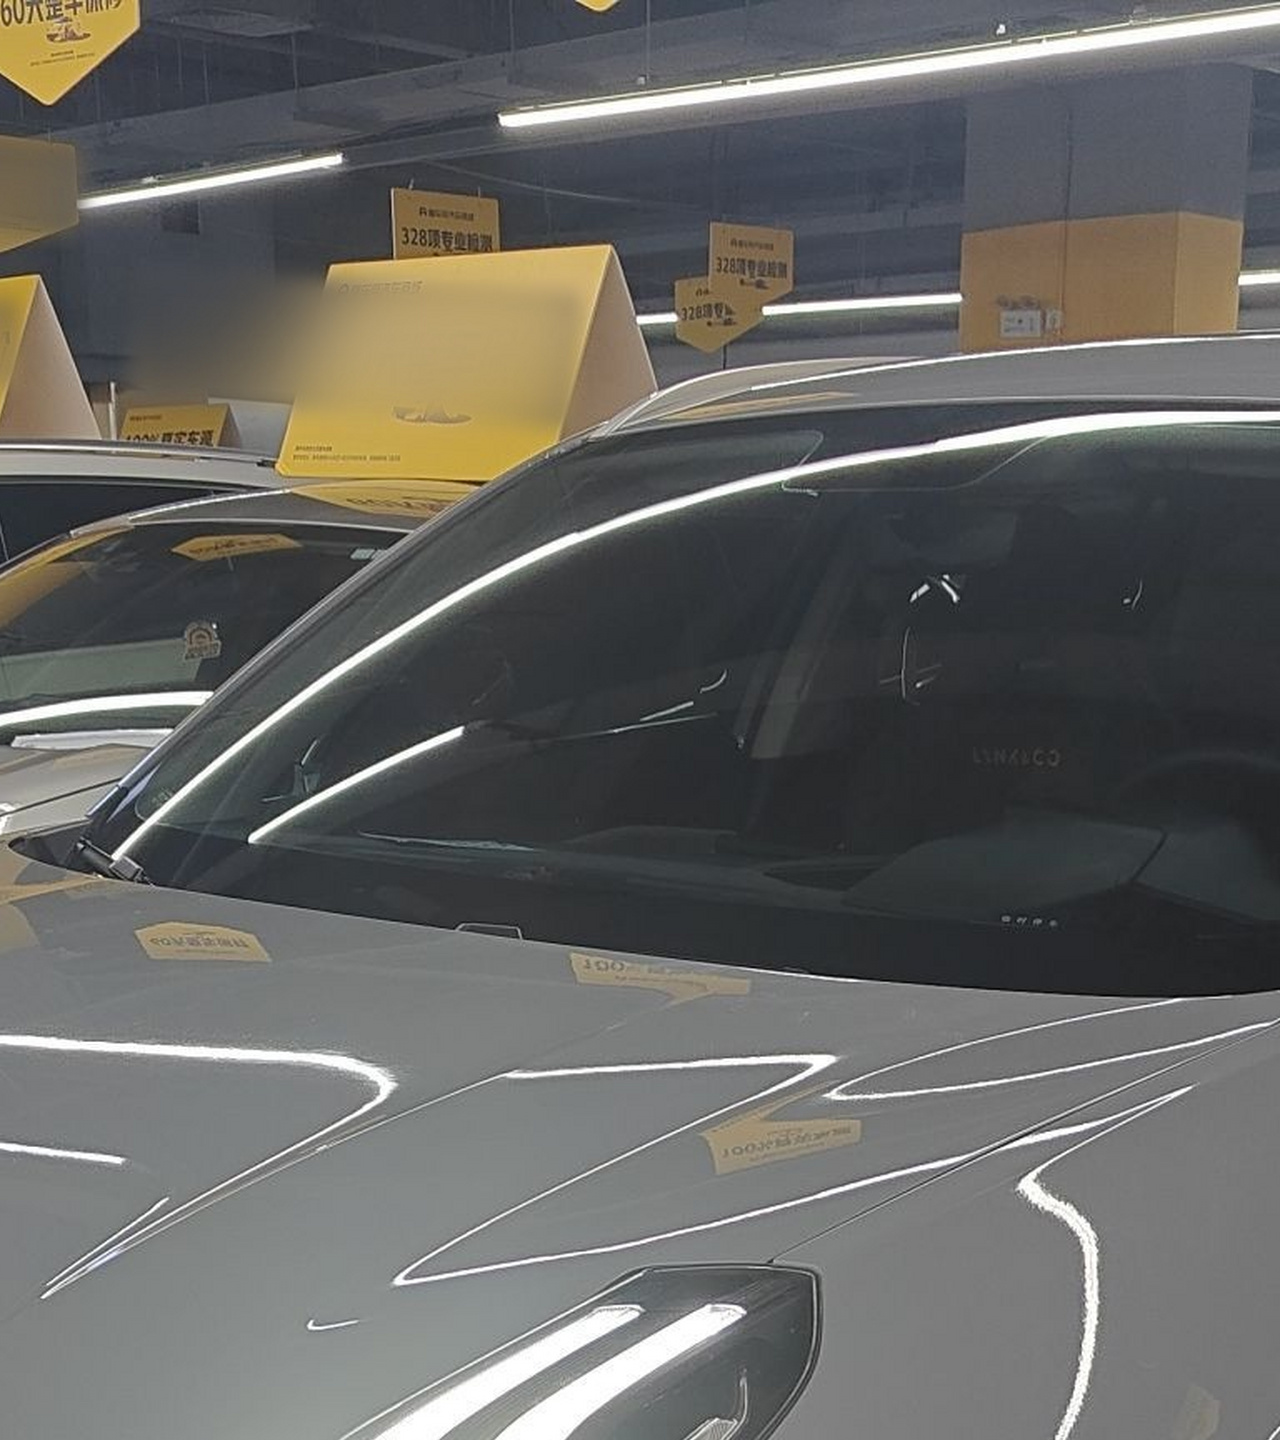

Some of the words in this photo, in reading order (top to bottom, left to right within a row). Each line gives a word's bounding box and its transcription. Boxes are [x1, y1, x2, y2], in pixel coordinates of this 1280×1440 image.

[0, 0, 120, 26] 60天整
[401, 227, 492, 252] 328项专业检测
